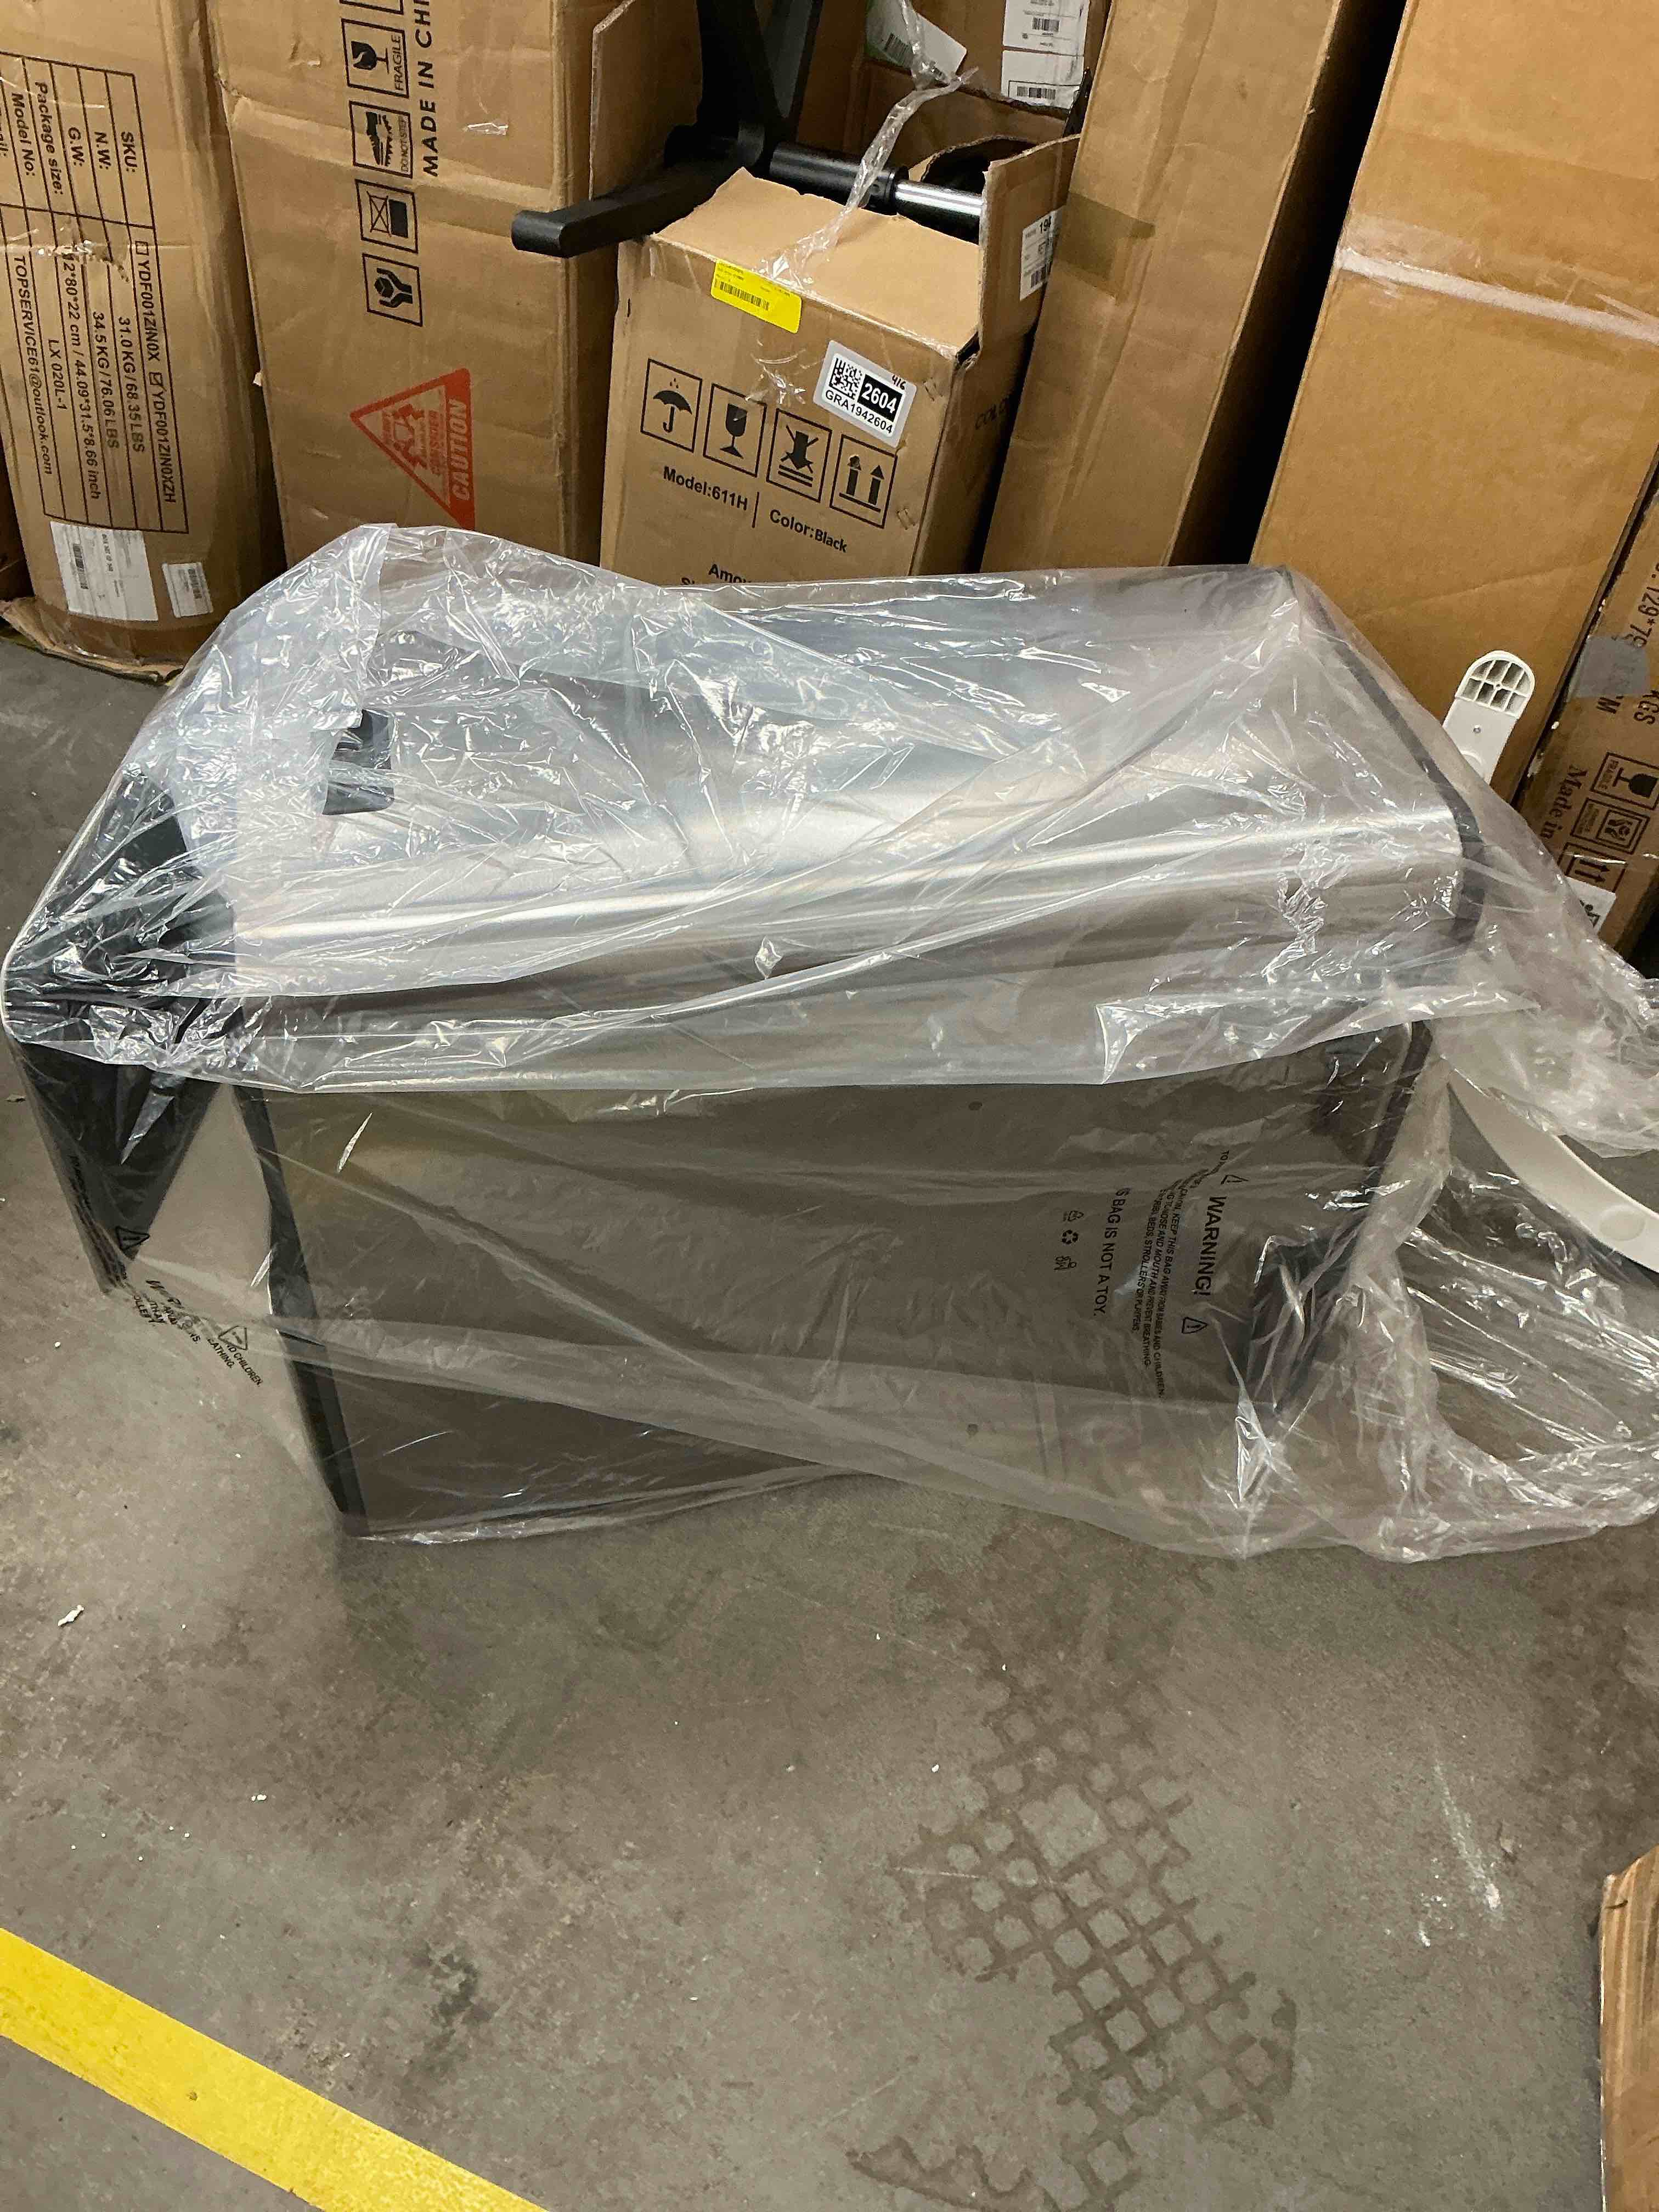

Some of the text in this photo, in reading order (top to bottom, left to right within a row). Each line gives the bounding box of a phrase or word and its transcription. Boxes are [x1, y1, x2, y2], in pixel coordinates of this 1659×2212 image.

[391, 35, 404, 92] FRAGILE
[417, 61, 435, 89] IN
[12, 92, 36, 176] Model No:
[35, 82, 64, 195] Package size:
[67, 127, 85, 167] G.W:
[94, 131, 111, 170] N.W:
[121, 131, 138, 172] SKU:
[420, 99, 439, 177] MADE
[14, 255, 52, 475] TOPSERVICE61@outlook.com
[48, 339, 67, 410] LX 020L-1
[891, 375, 906, 390] 416
[70, 324, 81, 347] cm
[88, 469, 101, 500] inch
[825, 390, 893, 434] GRA1942604
[861, 383, 897, 414] 2604
[448, 398, 470, 500] CAUTION
[663, 466, 748, 511] Model:611H
[769, 509, 848, 553] Color:Black
[1540, 765, 1588, 840] Made in
[1107, 1199, 1126, 1224] BAG
[1170, 1213, 1180, 1235] KEEP
[1104, 1227, 1118, 1239] IS
[1156, 1230, 1166, 1247] AND
[1166, 1235, 1176, 1255] THIS
[1194, 1195, 1228, 1296] WARNING!
[1099, 1243, 1115, 1271] NOT
[1137, 1240, 1153, 1288] STROLLERS
[1151, 1248, 1163, 1279] MOUTH
[1163, 1256, 1173, 1274] BAG
[1098, 1274, 1110, 1285] A
[1093, 1285, 1109, 1317] TOY.
[1153, 1335, 1162, 1350] AND
[233, 1352, 263, 1387] CHILDREN.
